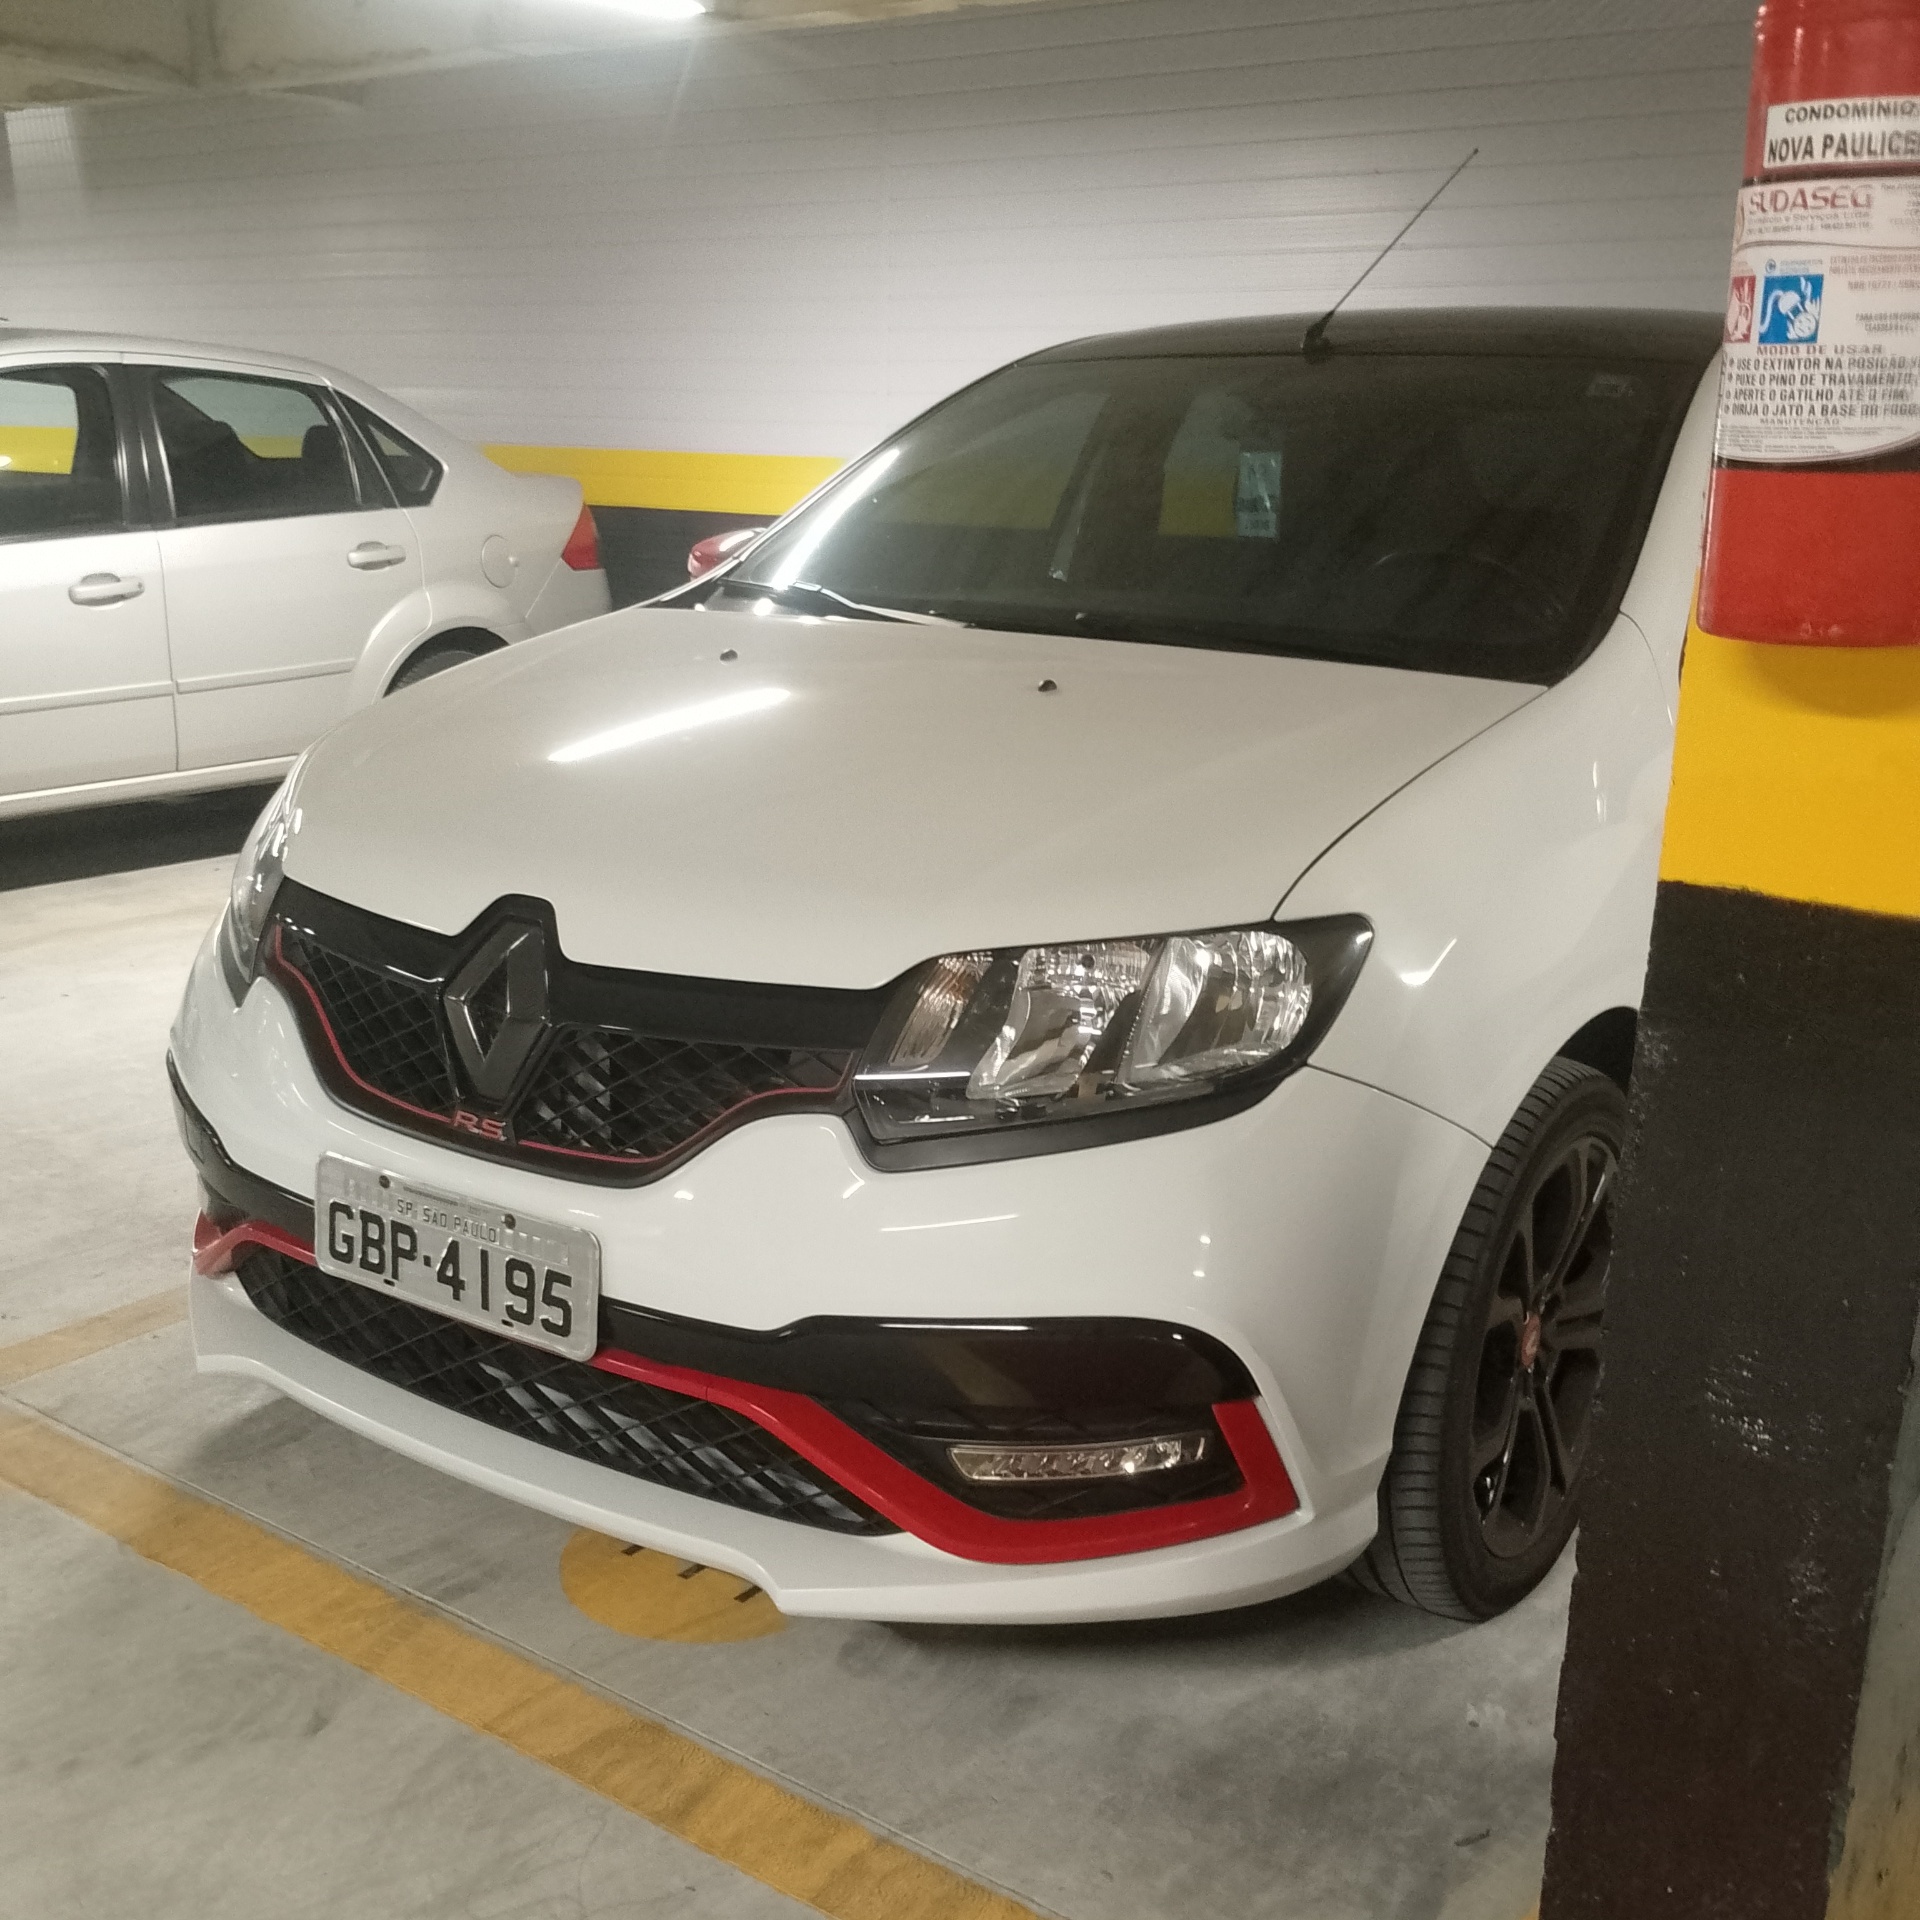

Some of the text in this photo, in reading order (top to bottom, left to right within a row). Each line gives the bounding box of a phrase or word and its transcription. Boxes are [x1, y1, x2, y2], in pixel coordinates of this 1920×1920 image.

[1767, 130, 1920, 164] NOVA PAULICE
[1757, 344, 1882, 355] MODO DE USAR
[1736, 357, 1752, 371] USE
[1754, 357, 1760, 371] O
[1763, 357, 1820, 371] EXTINTOR
[1825, 357, 1843, 370] NA
[1735, 373, 1757, 387] PUXE
[1759, 373, 1766, 386] O
[1769, 373, 1796, 386] PINO
[1800, 373, 1816, 386] DE
[1734, 387, 1766, 401] APERTE
[1769, 389, 1776, 401] O
[1780, 389, 1833, 401] GATILHO
[1732, 403, 1759, 416] DIRIJA
[1762, 404, 1769, 416] O
[1772, 404, 1804, 416] JATO
[1820, 404, 1857, 416] BASE
[453, 1109, 507, 1142] RS
[453, 1213, 497, 1243] PAULO
